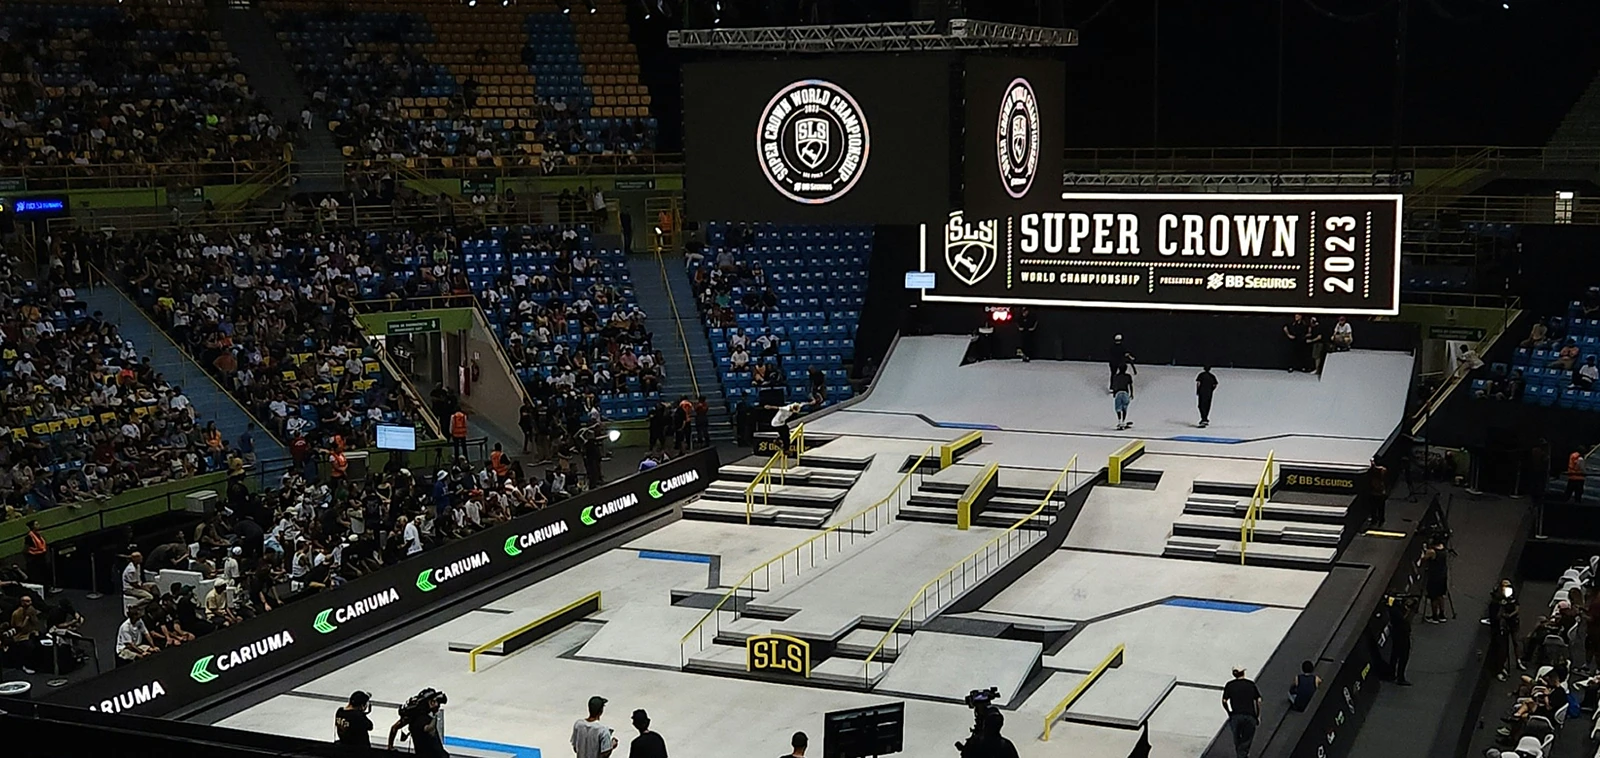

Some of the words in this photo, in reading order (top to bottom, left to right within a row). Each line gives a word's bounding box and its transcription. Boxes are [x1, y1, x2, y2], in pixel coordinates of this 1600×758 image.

[790, 88, 831, 107] WORLD
[764, 97, 792, 140] CROWN
[798, 121, 826, 140] SLS
[829, 96, 862, 183] CHAMPIONSHIP
[764, 141, 789, 182] SUPER
[949, 215, 993, 243] SLS
[1020, 212, 1140, 255] SUPER
[1158, 213, 1299, 257] CROWN
[1323, 215, 1356, 293] 2023
[1021, 271, 1056, 283] WORLD
[1059, 272, 1141, 285] CHAMPIONSHIP
[1159, 276, 1193, 285] PRESENTED
[1225, 275, 1243, 288] BB
[1244, 276, 1297, 289] SEGUROS
[660, 469, 700, 495] CARIUMA
[1298, 475, 1313, 486] BB
[1313, 476, 1354, 488] SEGUROS
[595, 493, 638, 519] CARIUMA
[520, 521, 569, 549] CARIUMA
[434, 551, 490, 582] CARIUMA
[335, 581, 400, 623] CARIUMA
[216, 630, 294, 671] CARIUMA
[753, 639, 802, 673] SLS
